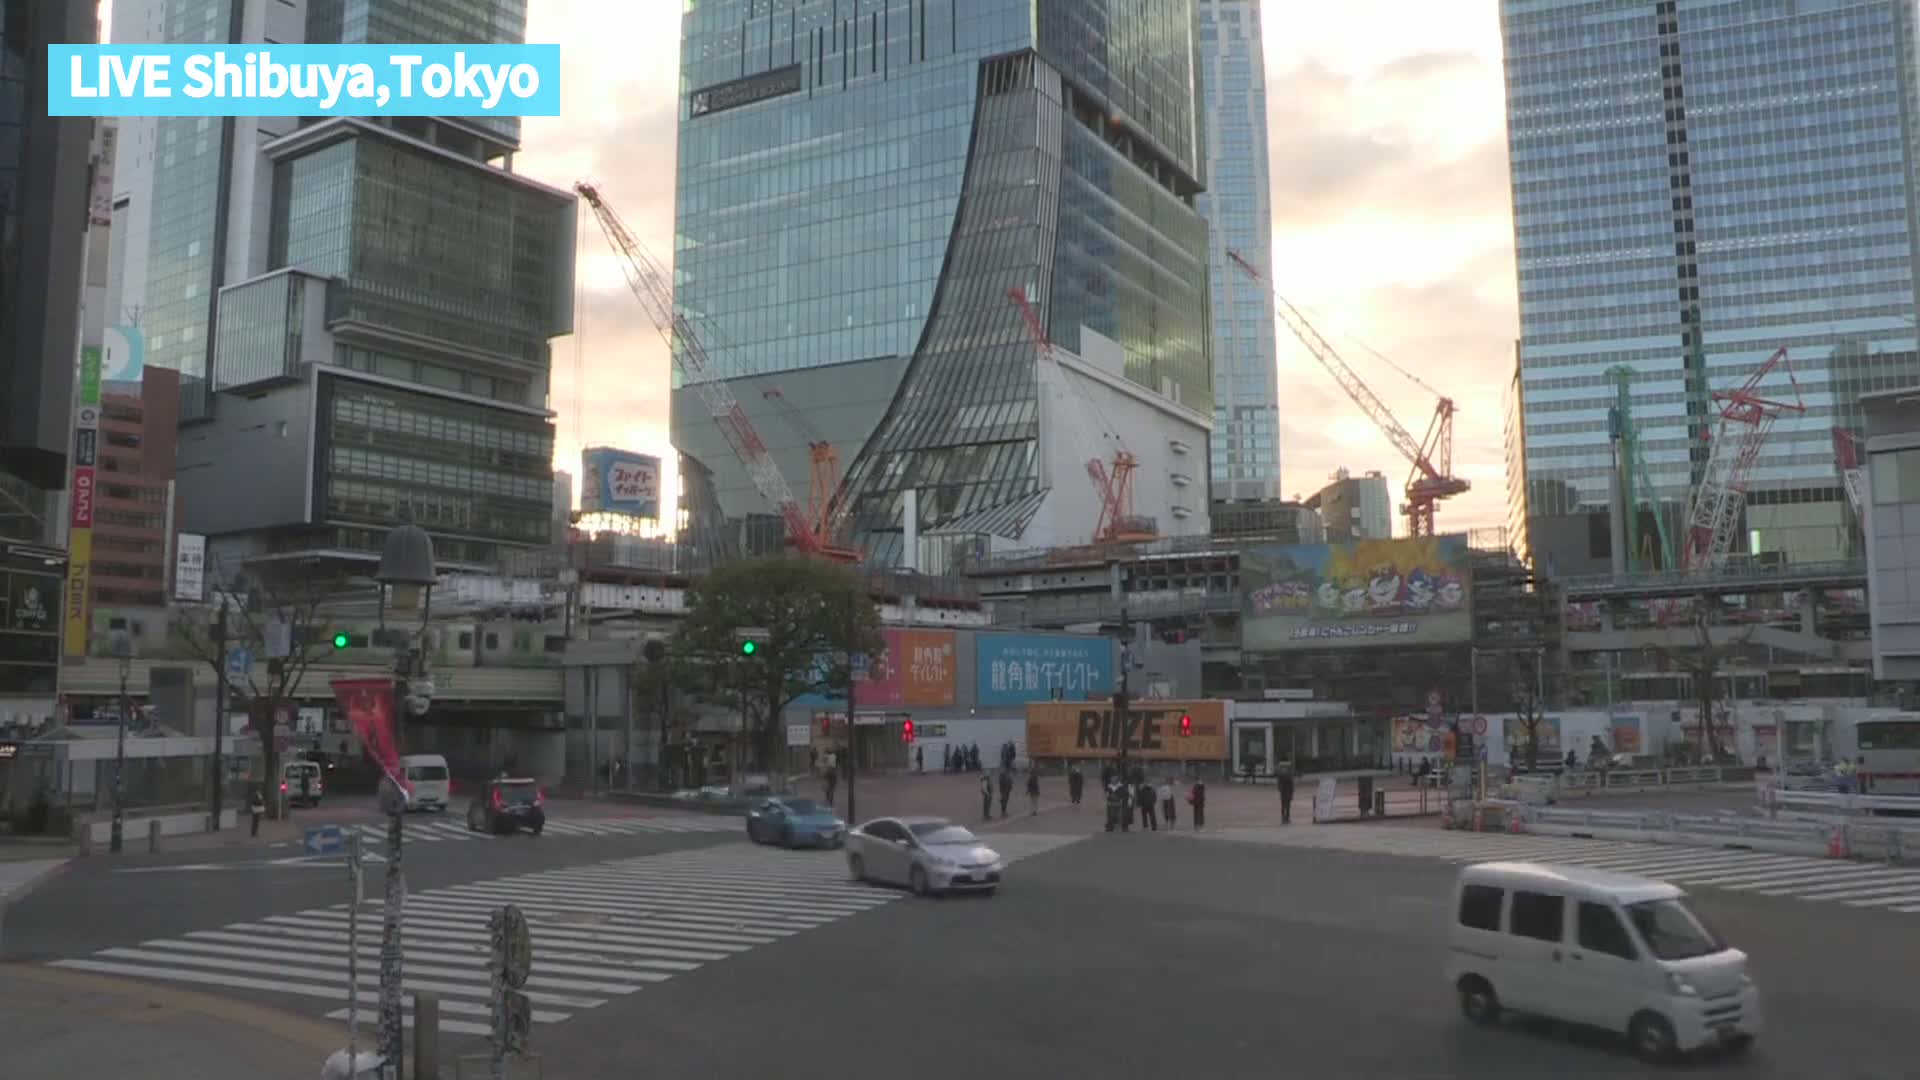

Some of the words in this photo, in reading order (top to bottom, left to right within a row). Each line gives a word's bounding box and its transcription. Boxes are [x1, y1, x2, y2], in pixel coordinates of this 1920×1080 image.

[614, 468, 653, 482] ファイト
[1076, 710, 1166, 749] RIIZE
